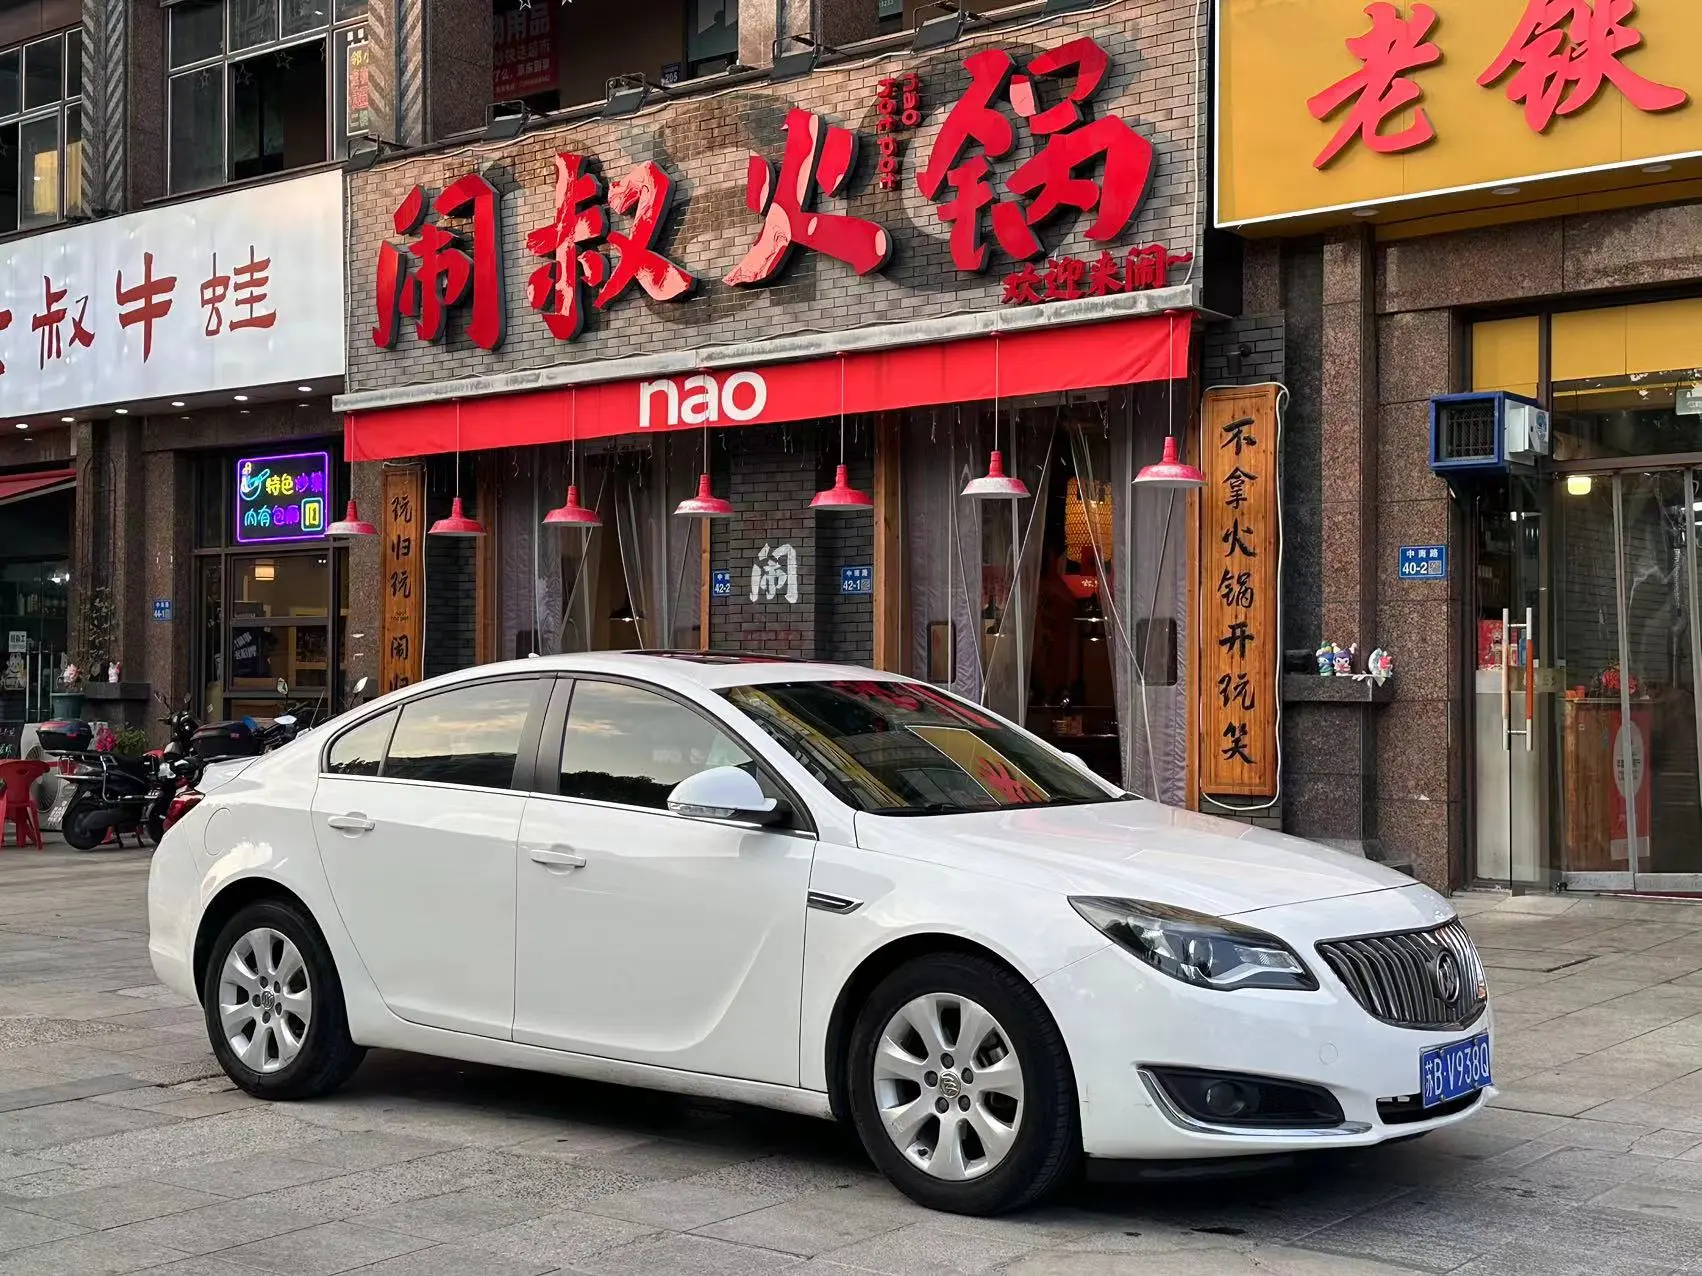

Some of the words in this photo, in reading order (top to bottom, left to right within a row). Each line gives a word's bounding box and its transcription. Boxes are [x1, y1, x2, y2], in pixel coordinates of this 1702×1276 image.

[373, 36, 1155, 350] 闹叔火锅
[639, 371, 767, 428] nao
[749, 543, 799, 604] 闹
[842, 580, 861, 590] 42-1
[1217, 416, 1258, 765] 不拿火锅开玩笑
[1402, 562, 1428, 574] 40-2
